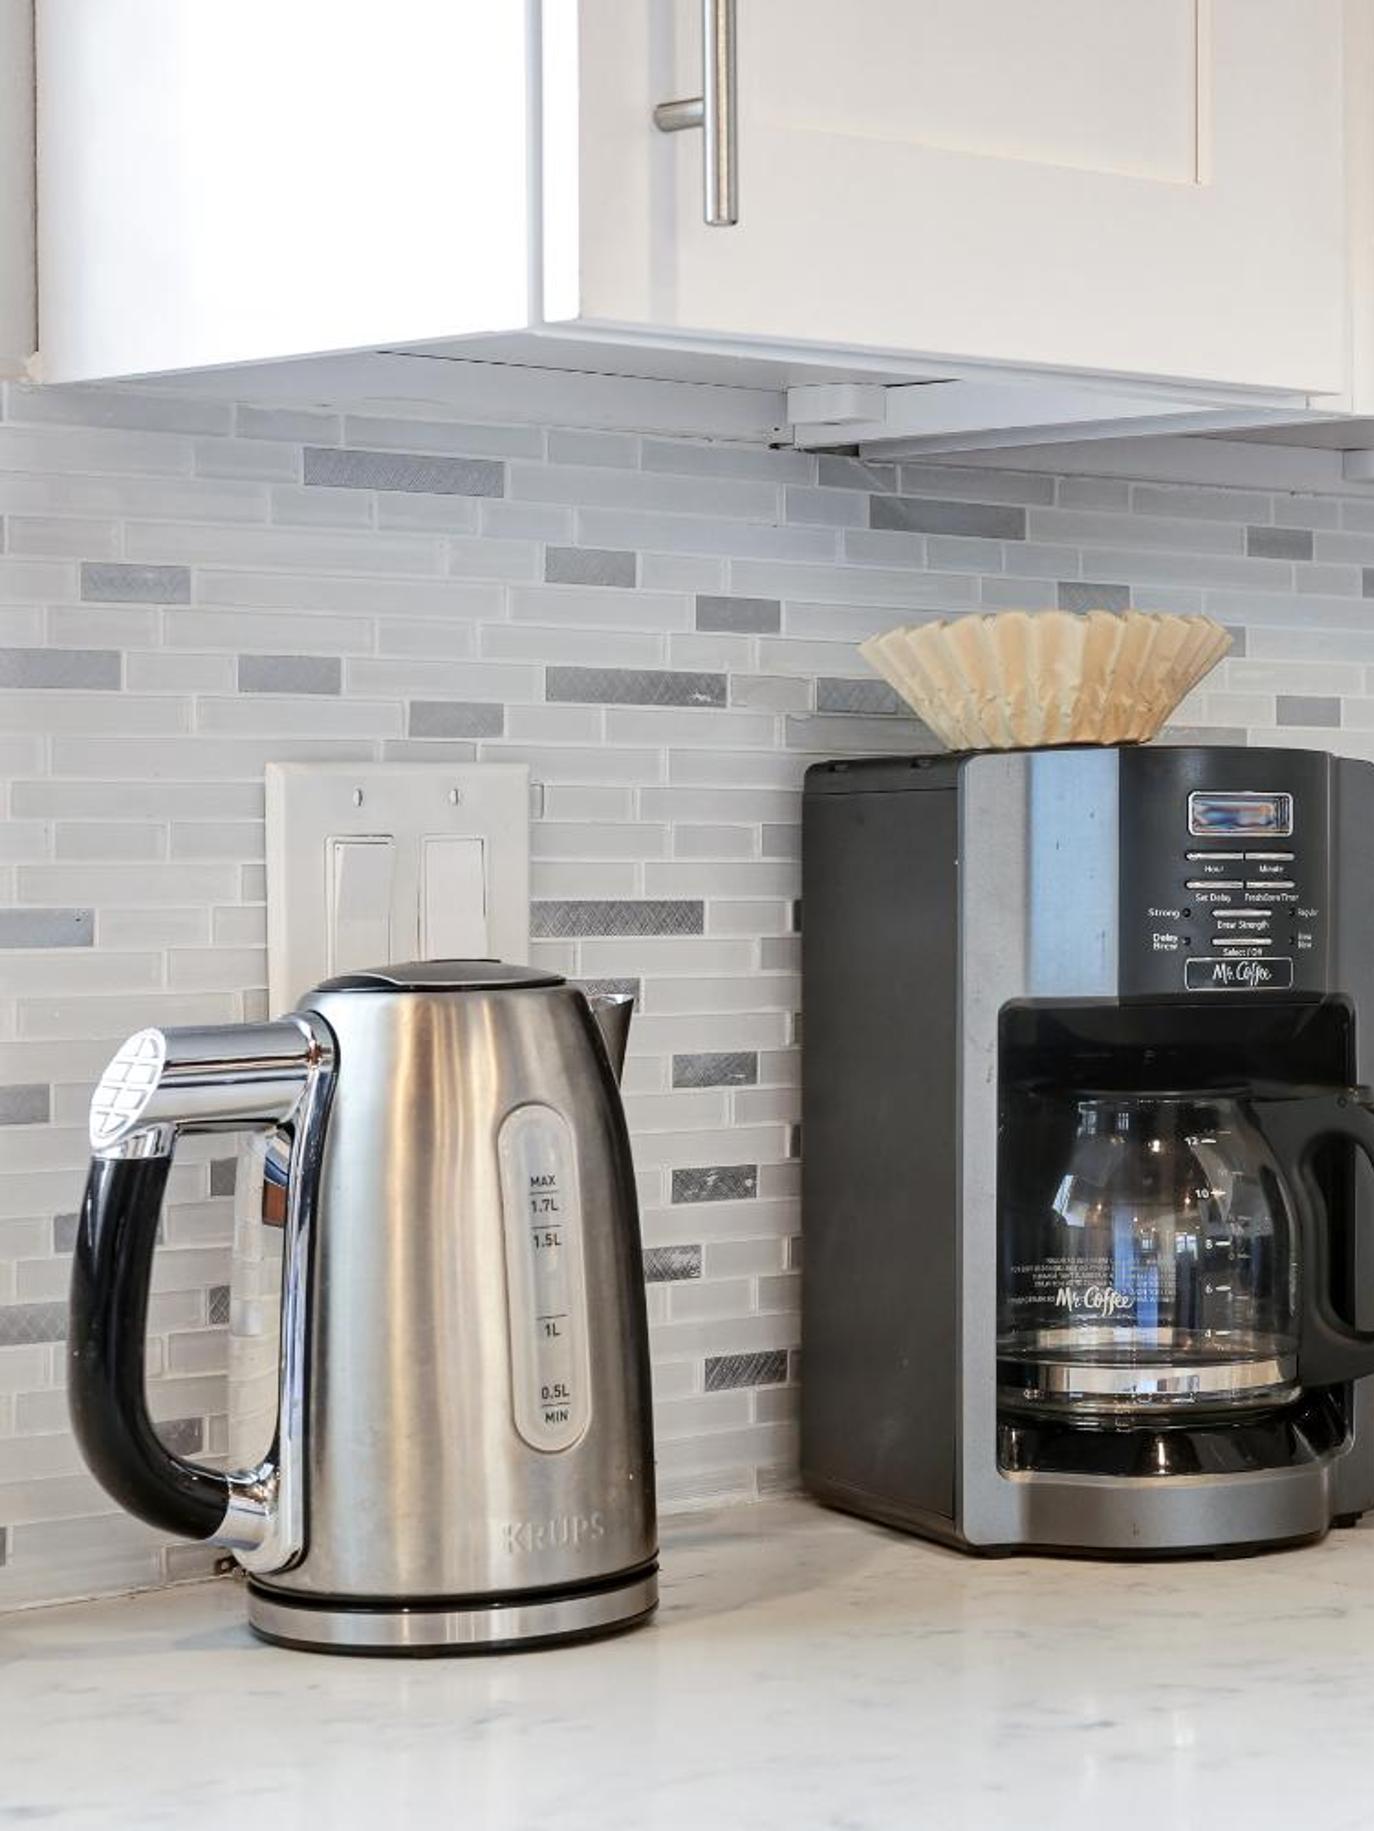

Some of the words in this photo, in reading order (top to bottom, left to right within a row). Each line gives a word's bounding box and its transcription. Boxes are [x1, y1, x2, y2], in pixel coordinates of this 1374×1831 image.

[1148, 908, 1181, 919] Strong
[1153, 933, 1178, 943] Delay
[1153, 941, 1178, 950] Brew
[1223, 948, 1246, 957] Select
[1212, 963, 1235, 985] Mr.
[1236, 961, 1273, 986] Coffee
[530, 1174, 556, 1187] MAX
[1195, 1188, 1209, 1199] 10
[531, 1198, 559, 1213] 1.7L
[533, 1232, 562, 1249] 1.5L
[1204, 1239, 1213, 1250] 8
[1204, 1284, 1213, 1294] 6
[1083, 1285, 1134, 1317] Coffee
[545, 1322, 562, 1337] 1L
[1204, 1329, 1212, 1339] 4
[541, 1383, 571, 1400] 0.5L
[545, 1410, 569, 1423] MIN
[500, 1511, 605, 1553] KRUPS
